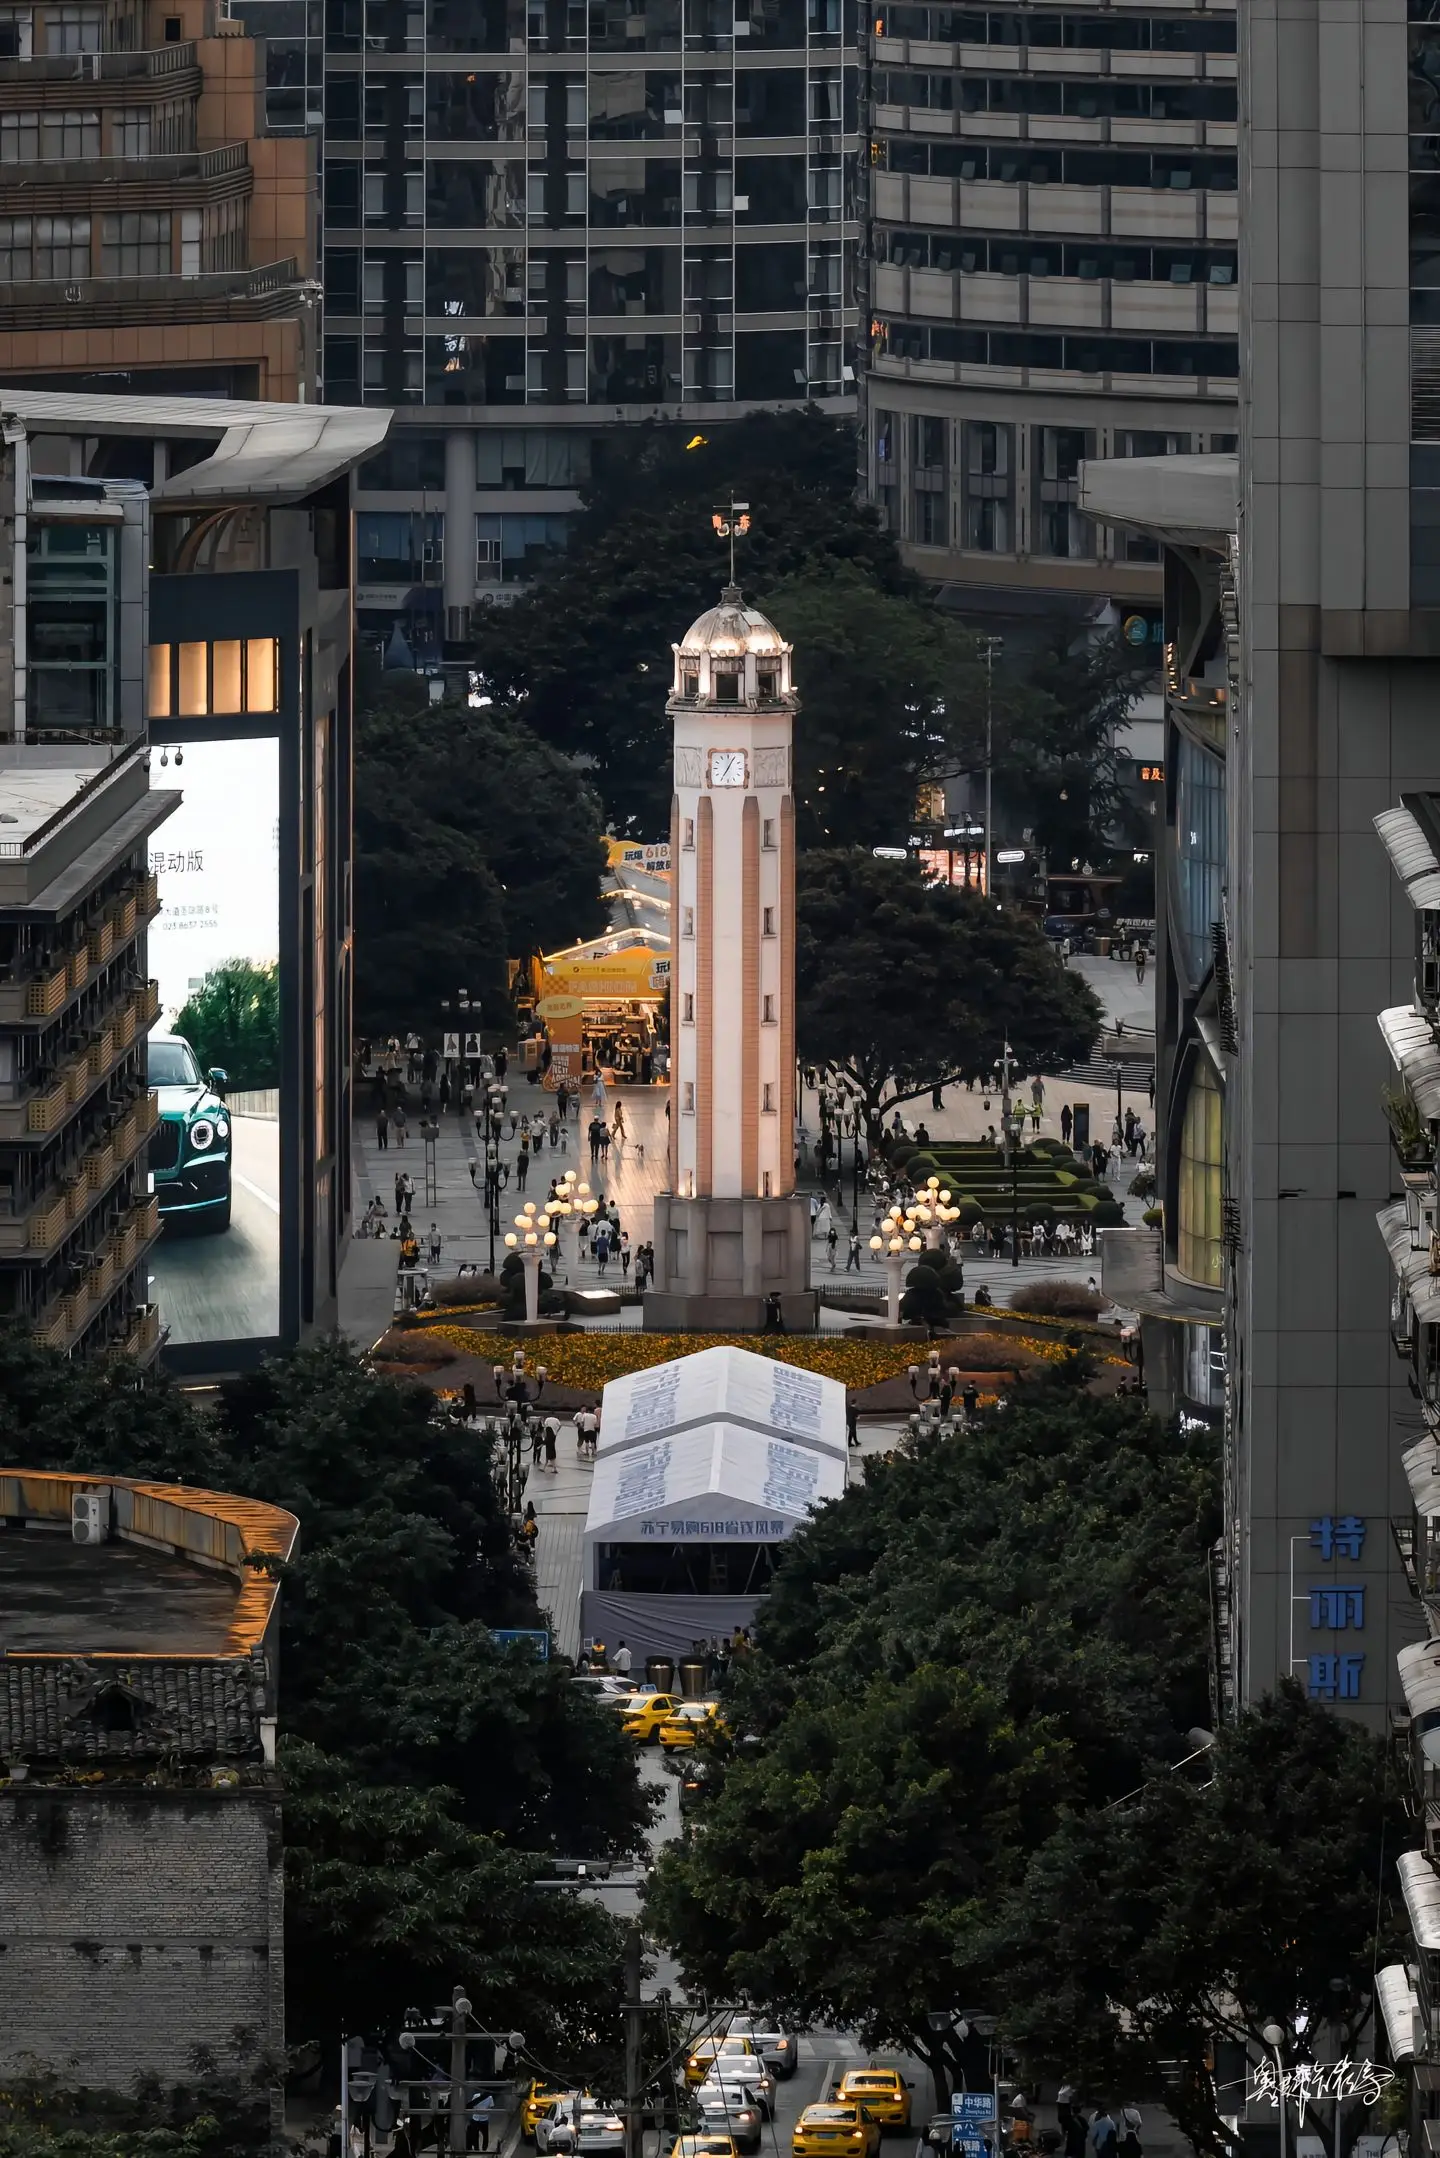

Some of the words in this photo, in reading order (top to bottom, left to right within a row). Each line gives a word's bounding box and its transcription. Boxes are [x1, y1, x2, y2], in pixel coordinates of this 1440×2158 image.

[149, 849, 204, 874] 混动版
[1308, 1515, 1367, 1699] 特丽斯
[964, 2096, 992, 2109] 中华路
